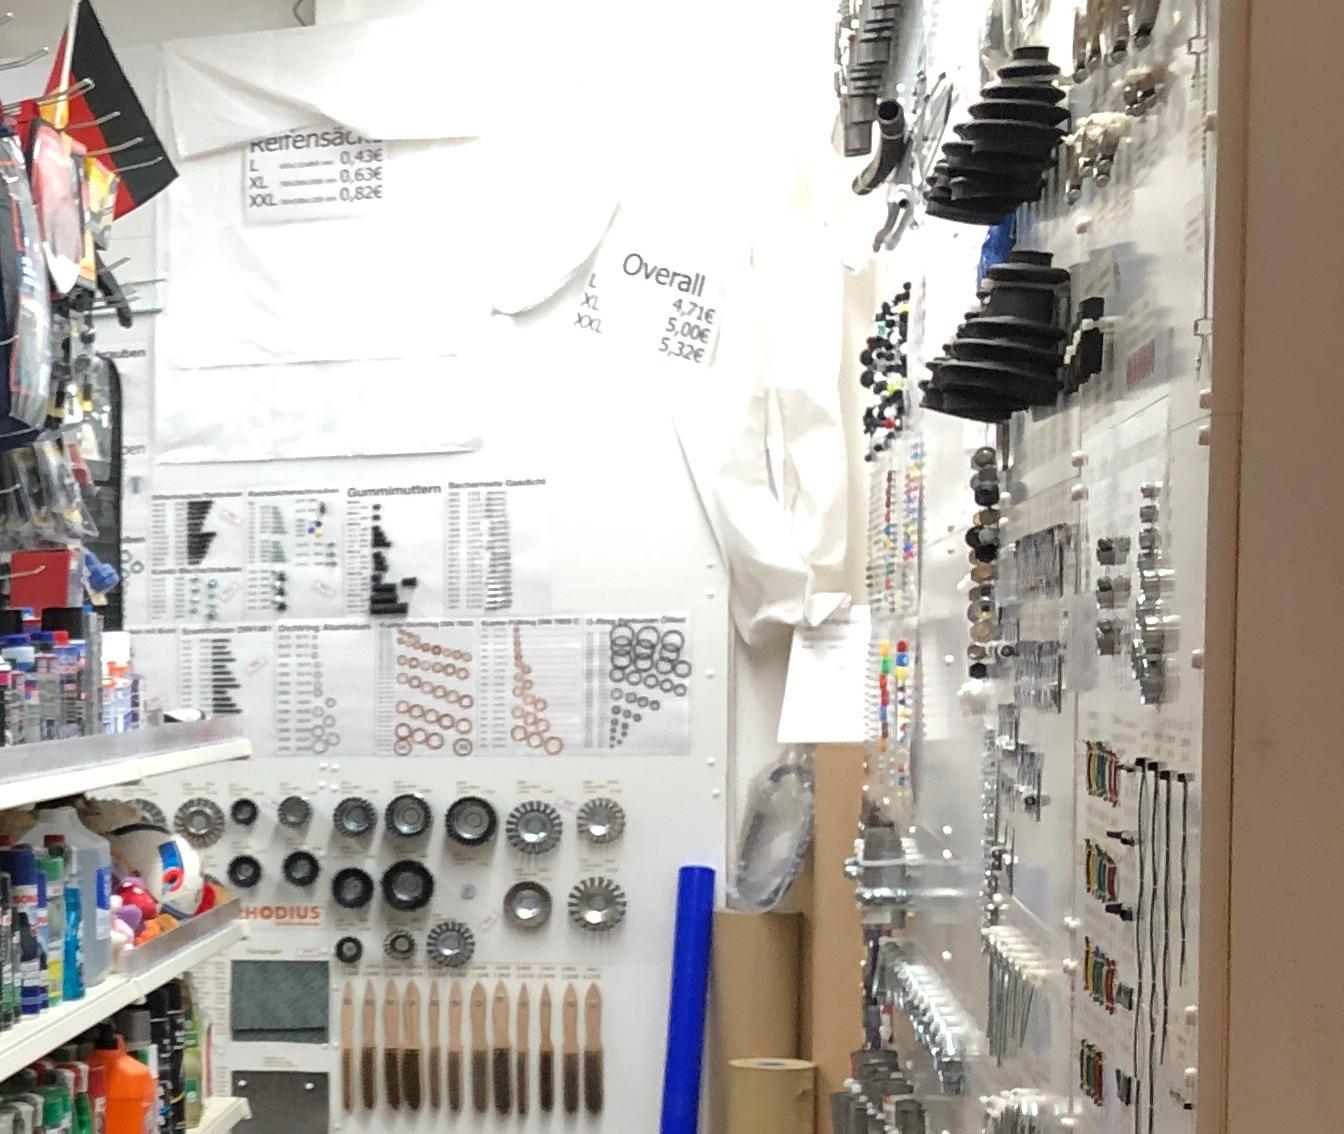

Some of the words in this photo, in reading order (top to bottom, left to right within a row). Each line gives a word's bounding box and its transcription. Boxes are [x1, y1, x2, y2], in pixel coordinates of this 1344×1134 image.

[250, 159, 258, 172] L
[339, 150, 383, 166] 0,43€
[249, 176, 268, 190] XL
[340, 167, 382, 184] 0,63€
[249, 193, 276, 207] XXL
[340, 185, 382, 202] 0,82€
[622, 253, 706, 297] Overall
[588, 273, 597, 289] L
[672, 299, 716, 324] 4,71€
[580, 293, 599, 311] XL
[666, 317, 710, 344] 5,00€
[574, 313, 602, 334] XXL
[658, 338, 705, 363] 5,32€
[347, 485, 442, 498] Gummimuttern
